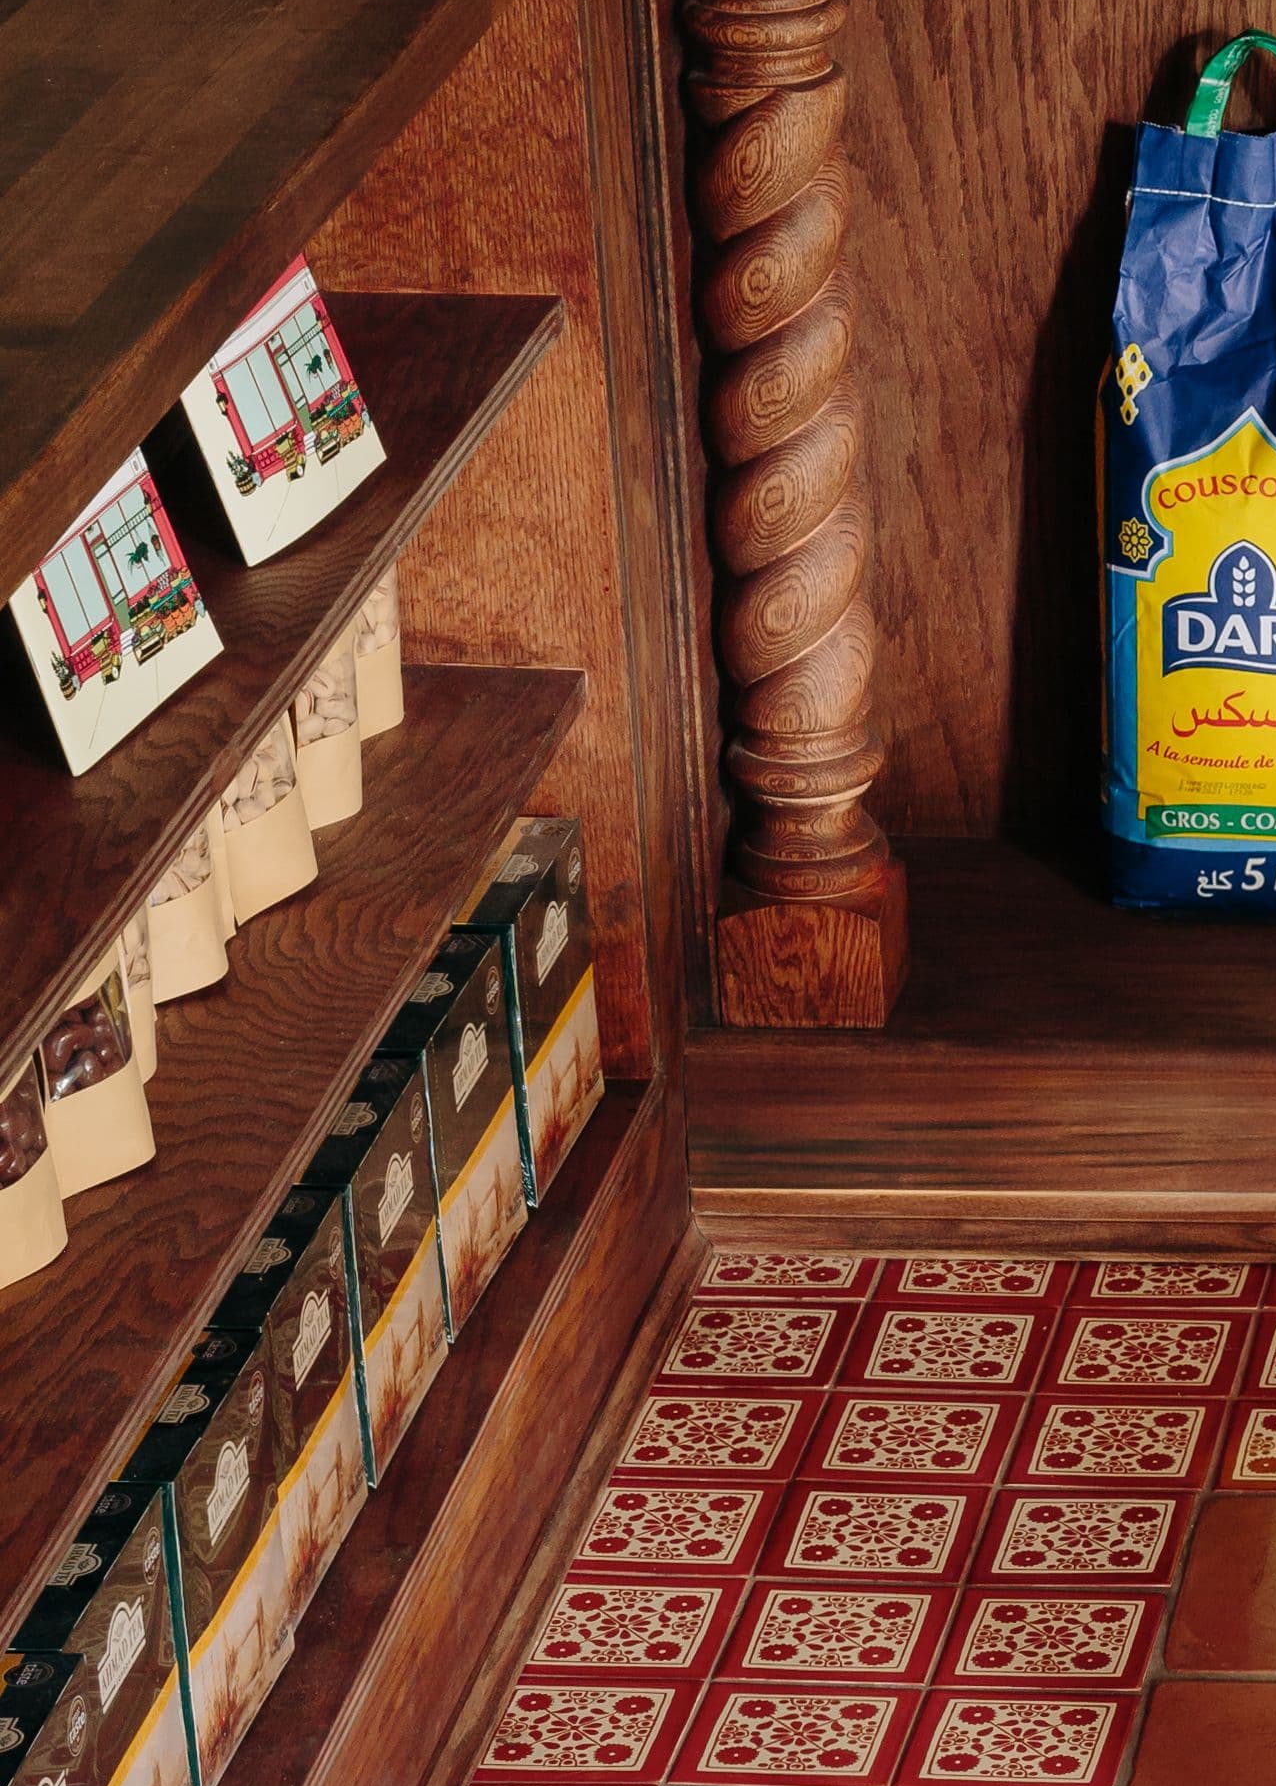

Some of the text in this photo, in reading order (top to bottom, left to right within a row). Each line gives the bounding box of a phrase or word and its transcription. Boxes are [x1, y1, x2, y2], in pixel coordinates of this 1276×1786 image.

[1146, 740, 1160, 756] A
[1163, 745, 1180, 761] la
[1180, 753, 1249, 769] semoule
[1254, 754, 1274, 769] de
[1161, 810, 1220, 830] GROS
[1197, 869, 1234, 898] كلغ
[1240, 857, 1266, 891] 5
[100, 1633, 129, 1691] AHMAD
